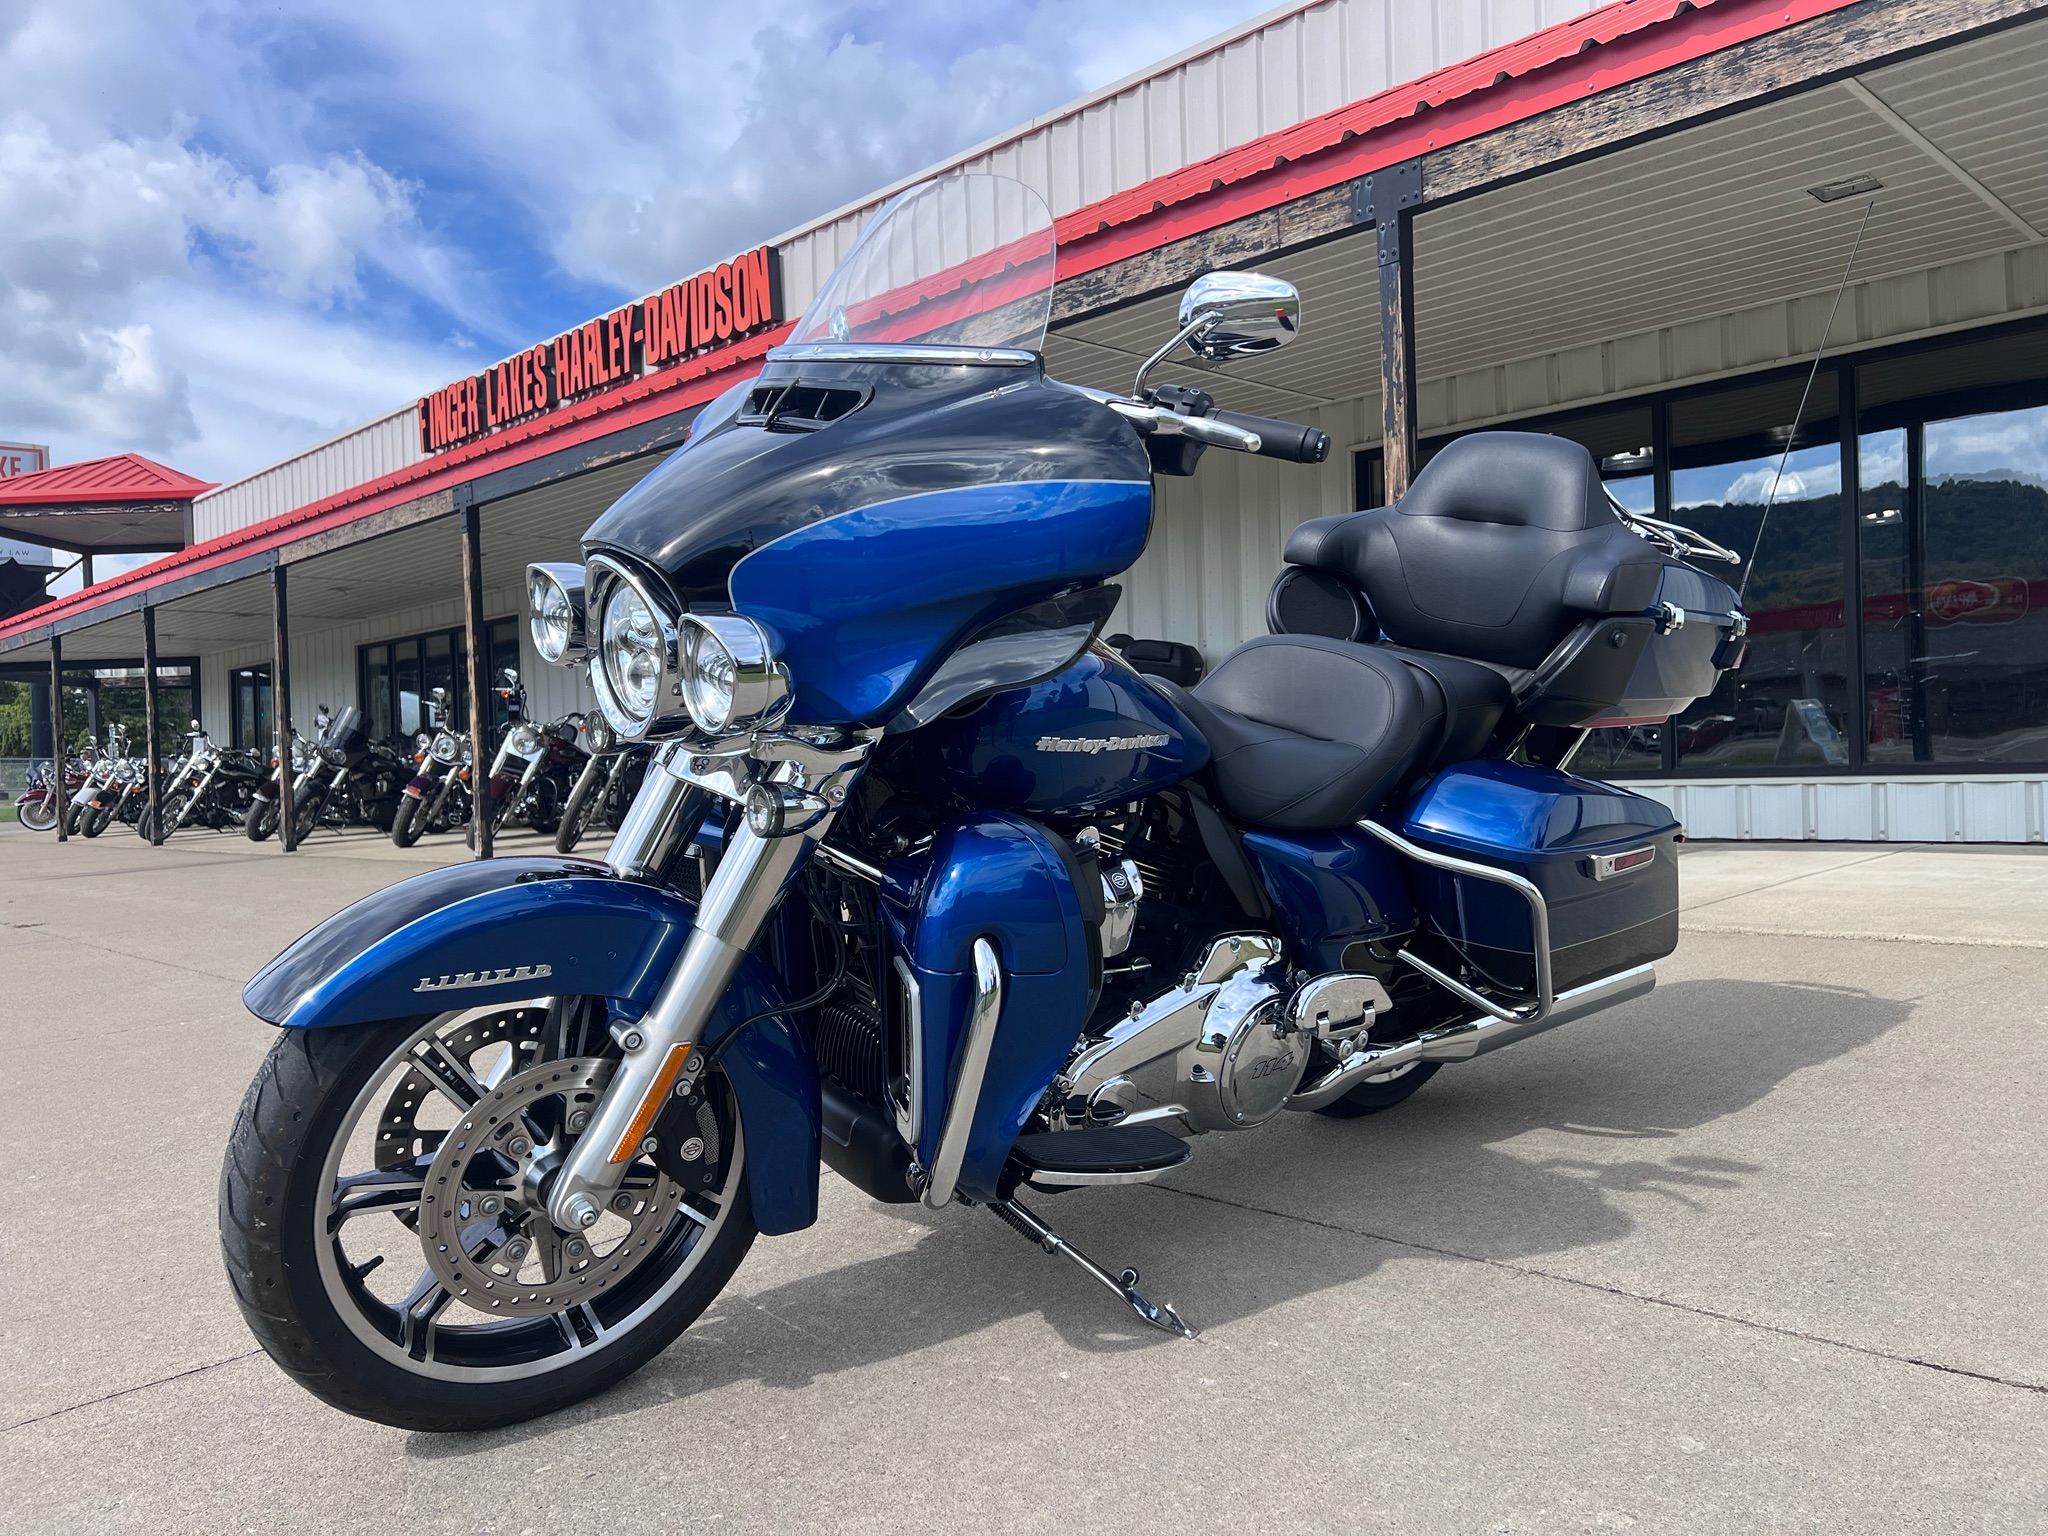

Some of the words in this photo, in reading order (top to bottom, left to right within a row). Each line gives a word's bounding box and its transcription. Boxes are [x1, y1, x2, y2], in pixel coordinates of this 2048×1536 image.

[418, 375, 480, 453] FINGER
[485, 344, 547, 426] LAKES
[554, 246, 773, 400] HARLEY-DAVIDSON
[1036, 734, 1169, 754] Harley-Davidson
[414, 964, 552, 992] LIMITED
[1251, 1051, 1294, 1080] 114
